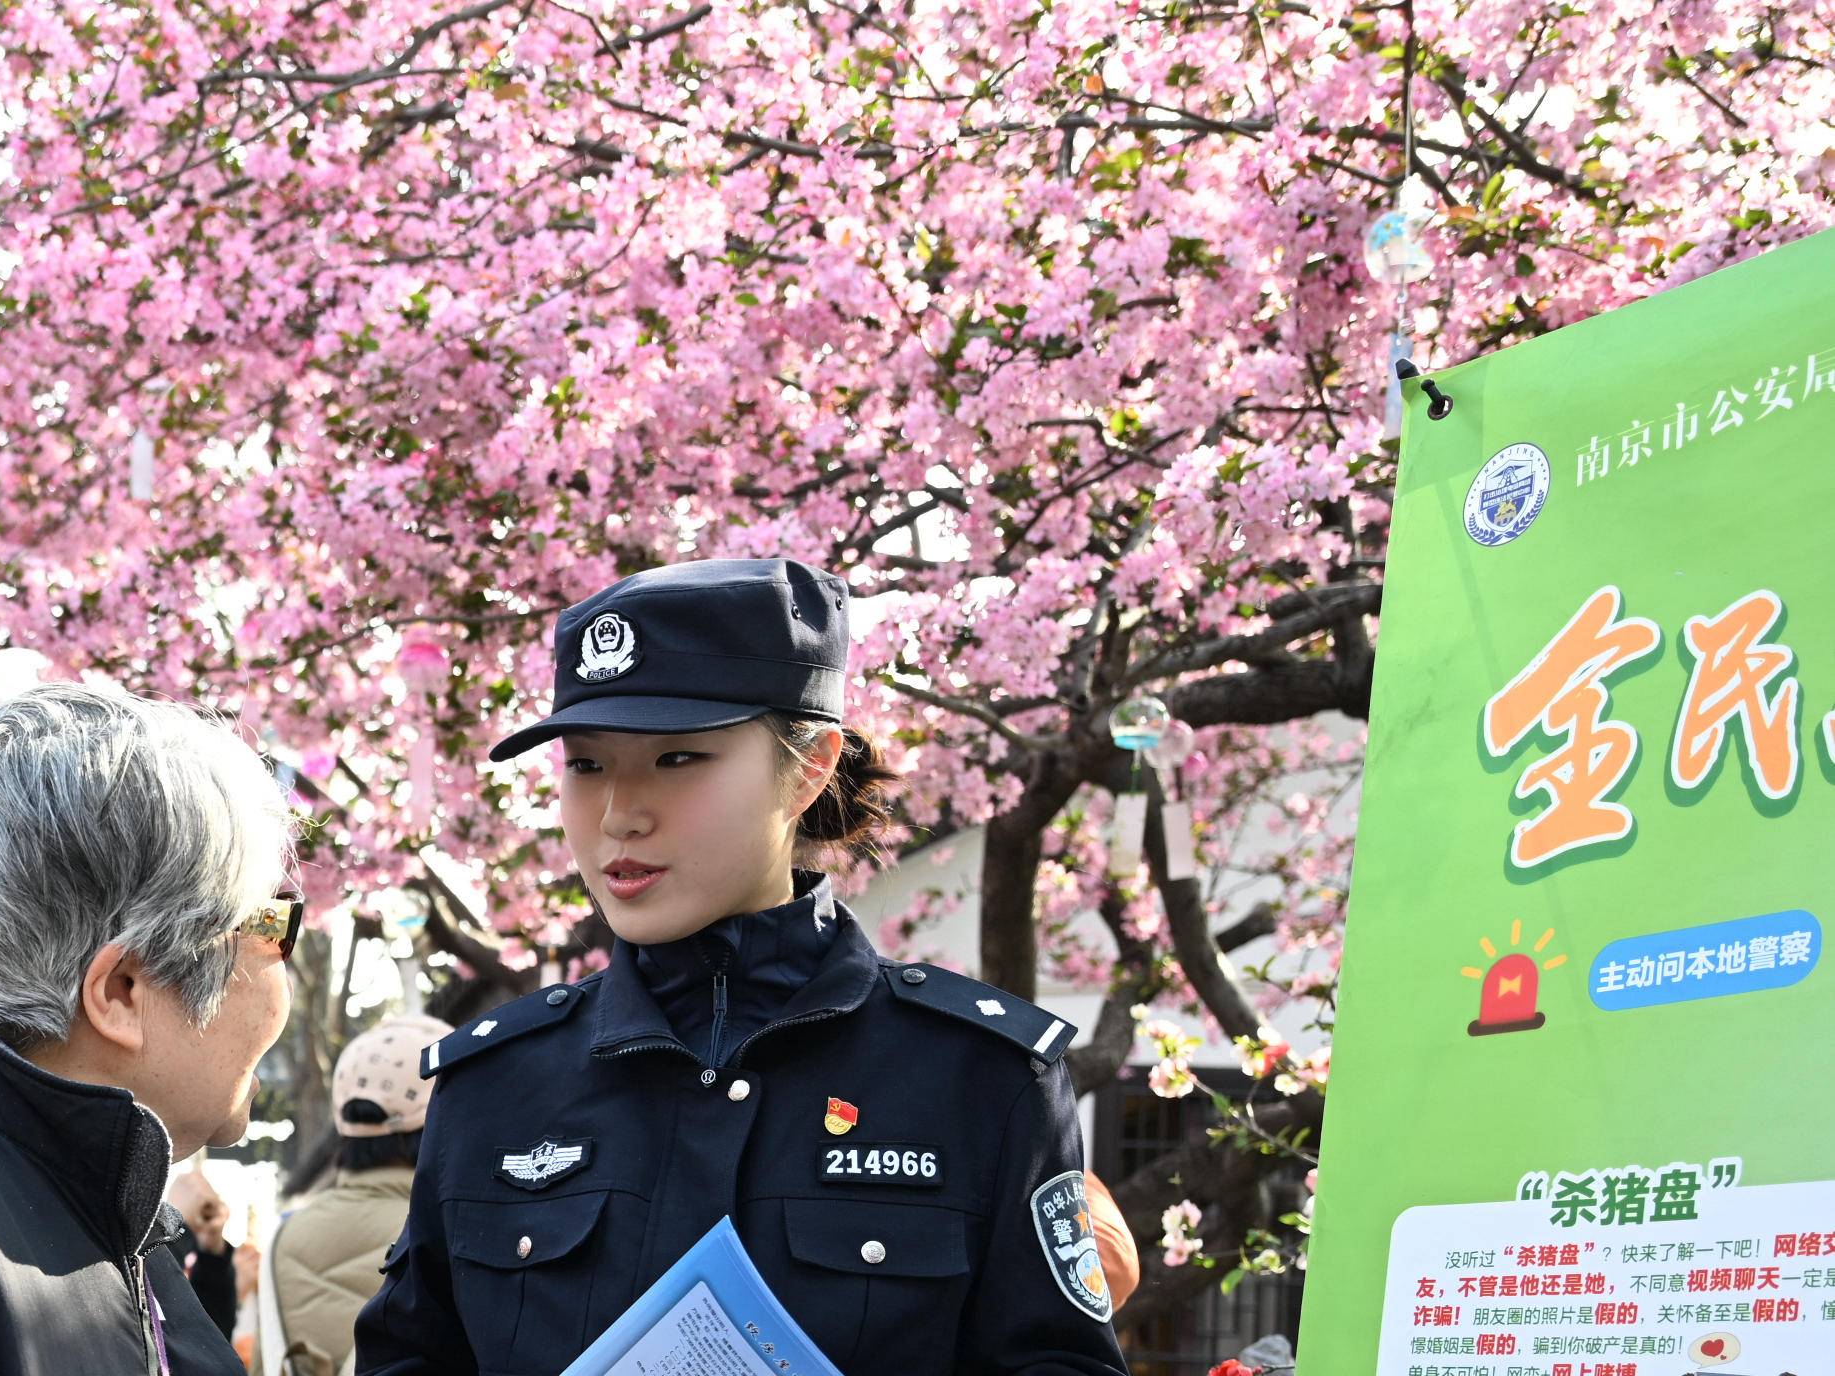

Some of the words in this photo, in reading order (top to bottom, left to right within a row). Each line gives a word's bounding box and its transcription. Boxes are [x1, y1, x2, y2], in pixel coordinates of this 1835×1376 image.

[1575, 347, 1835, 487] 南京市公安局
[588, 668, 616, 680] POLICE
[1485, 585, 1835, 868] 全民
[1596, 930, 1812, 993] 主动问本地警察
[826, 1149, 937, 1178] 214966
[1520, 1163, 1736, 1228] “杀猪盘”
